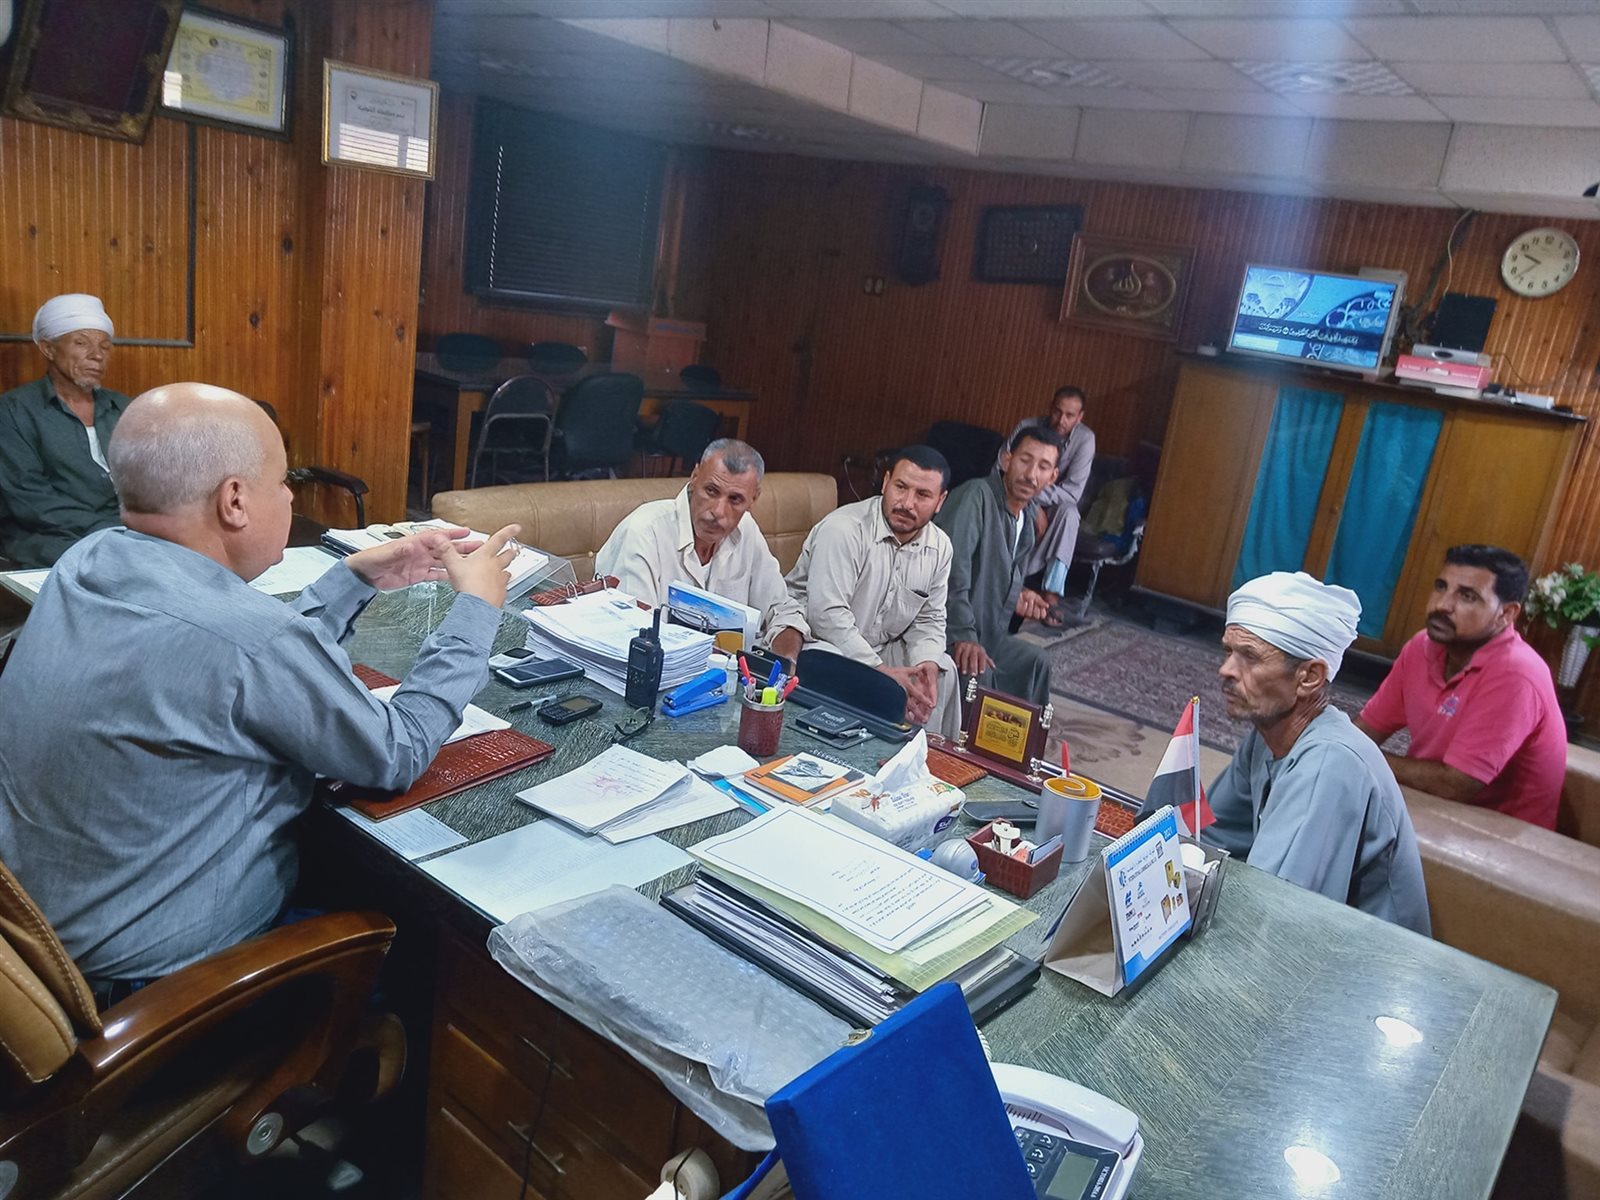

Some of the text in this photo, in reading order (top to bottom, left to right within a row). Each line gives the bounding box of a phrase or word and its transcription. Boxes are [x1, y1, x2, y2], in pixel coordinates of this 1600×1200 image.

[1532, 236, 1540, 246] 11
[1545, 235, 1555, 245] 12
[1520, 243, 1530, 252] 10
[1558, 241, 1564, 249] 1
[1511, 254, 1518, 262] 9
[1510, 266, 1518, 275] 8
[1518, 277, 1524, 285] 7
[1553, 275, 1560, 283] 4
[1541, 281, 1548, 289] 5
